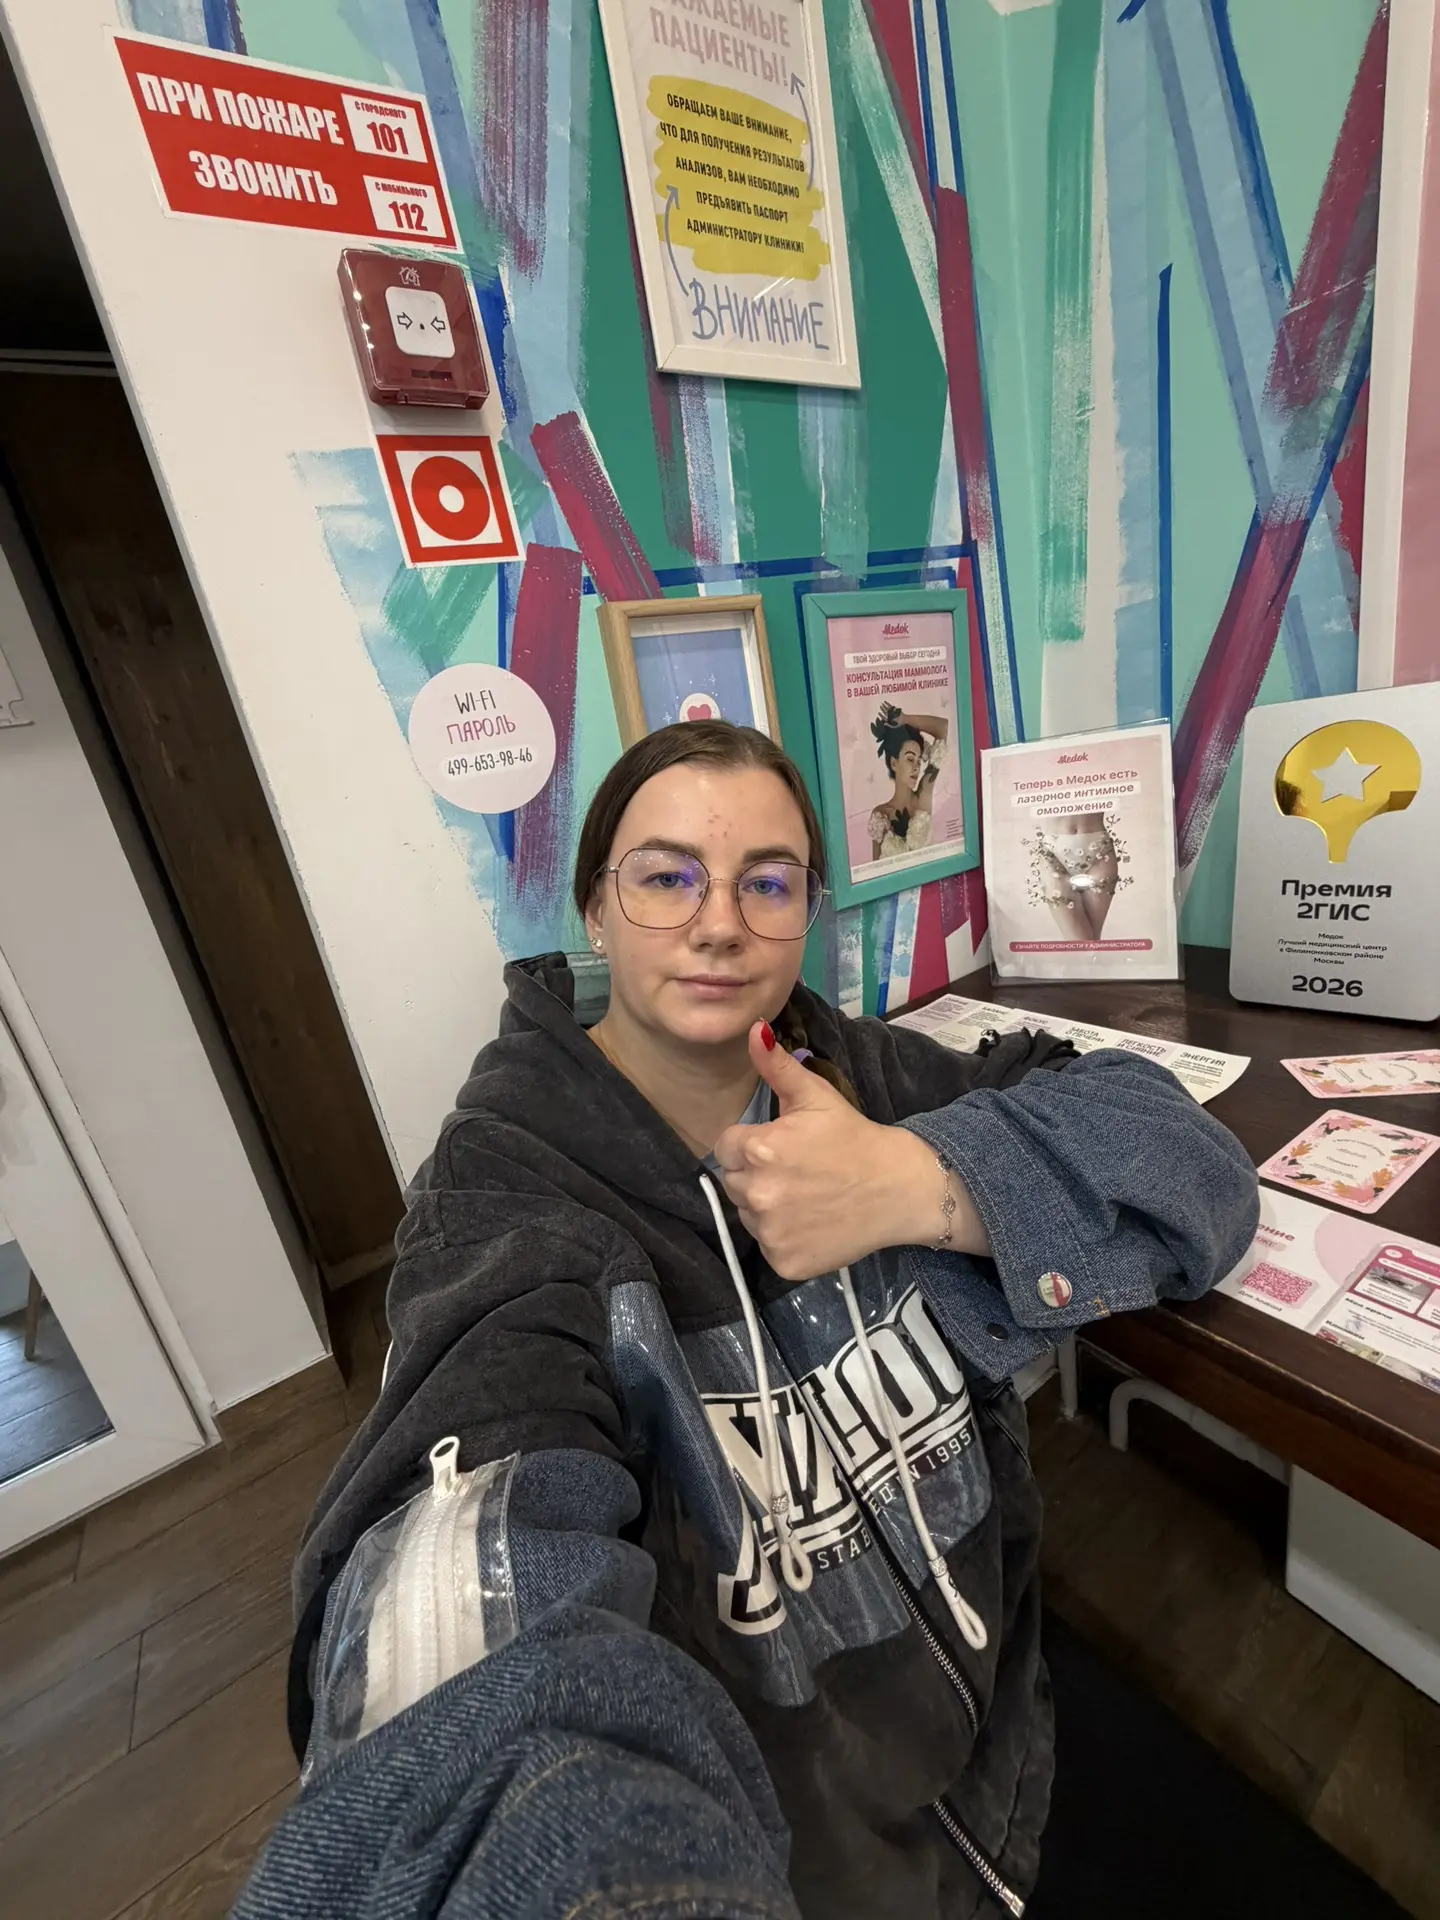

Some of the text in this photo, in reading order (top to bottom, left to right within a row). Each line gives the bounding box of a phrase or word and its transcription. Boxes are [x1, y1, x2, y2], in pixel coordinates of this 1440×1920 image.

[650, 6, 788, 86] ПАЦИЕНТЫ!
[136, 72, 344, 145] ПРИ ПОЖАРЕ
[355, 101, 407, 119] С ГОРОДСКОГО
[667, 93, 792, 144] ОБРАЩАЕМ ВАШЕ ВНИМАНИЕ,
[367, 122, 408, 155] 101
[660, 121, 805, 172] ЧТО ДЛЯ ПОЛУЧЕНИЯ РЕЗУЛЬТАТОВ
[189, 150, 338, 205] ЗВОНИТЬ
[676, 157, 800, 198] АНАЛИЗОВ, ВАМ НЕОБХОДИМО
[375, 182, 428, 198] С МОБИЛЬНОГО
[388, 201, 428, 231] 112
[696, 191, 788, 223] ПРЕДЪЯВИТЬ ПАСПОРТ
[687, 218, 805, 253] АДМИНИСТРАТОРУ КЛИНИКИ!
[689, 277, 830, 350] ВНИМАНИЕ
[853, 649, 941, 664] ТВОЙ ЗДОРОВЫЙ ВЫБОР СЕГОДНЯ
[846, 665, 948, 684] КОНСУЛЬТАЦИЯ МАММОЛОГА
[847, 678, 948, 698] В ВАШЕЙ ЛЮБИМОЙ КЛИНИКЕ
[454, 689, 497, 715] WI-FI
[446, 714, 516, 745] ПАРОЛЬ
[448, 747, 533, 776] 499-653-98-46
[1013, 769, 1138, 791] Теперь в Медок есть
[1017, 783, 1134, 804] лазерное интимное
[1037, 800, 1113, 816] омоложение
[1281, 879, 1392, 900] Премия
[1297, 902, 1370, 921] 2ГИС
[1015, 942, 1040, 950] УЗНАЙТЕ
[1040, 942, 1084, 950] ПОДРОБНОСТИ
[1089, 941, 1146, 949] АДМИНИСТРАТОРА
[1277, 938, 1307, 946] Лучший
[1308, 941, 1361, 949] медицинский
[1318, 932, 1344, 940] Медок
[1313, 957, 1345, 965] Москвы
[1354, 952, 1384, 960] районе
[1292, 975, 1363, 998] 2026
[1121, 1038, 1167, 1053] ЛЕГКОСТЬ
[1179, 1052, 1226, 1067] ЭНЕРГИЯ
[926, 1428, 971, 1469] 1995
